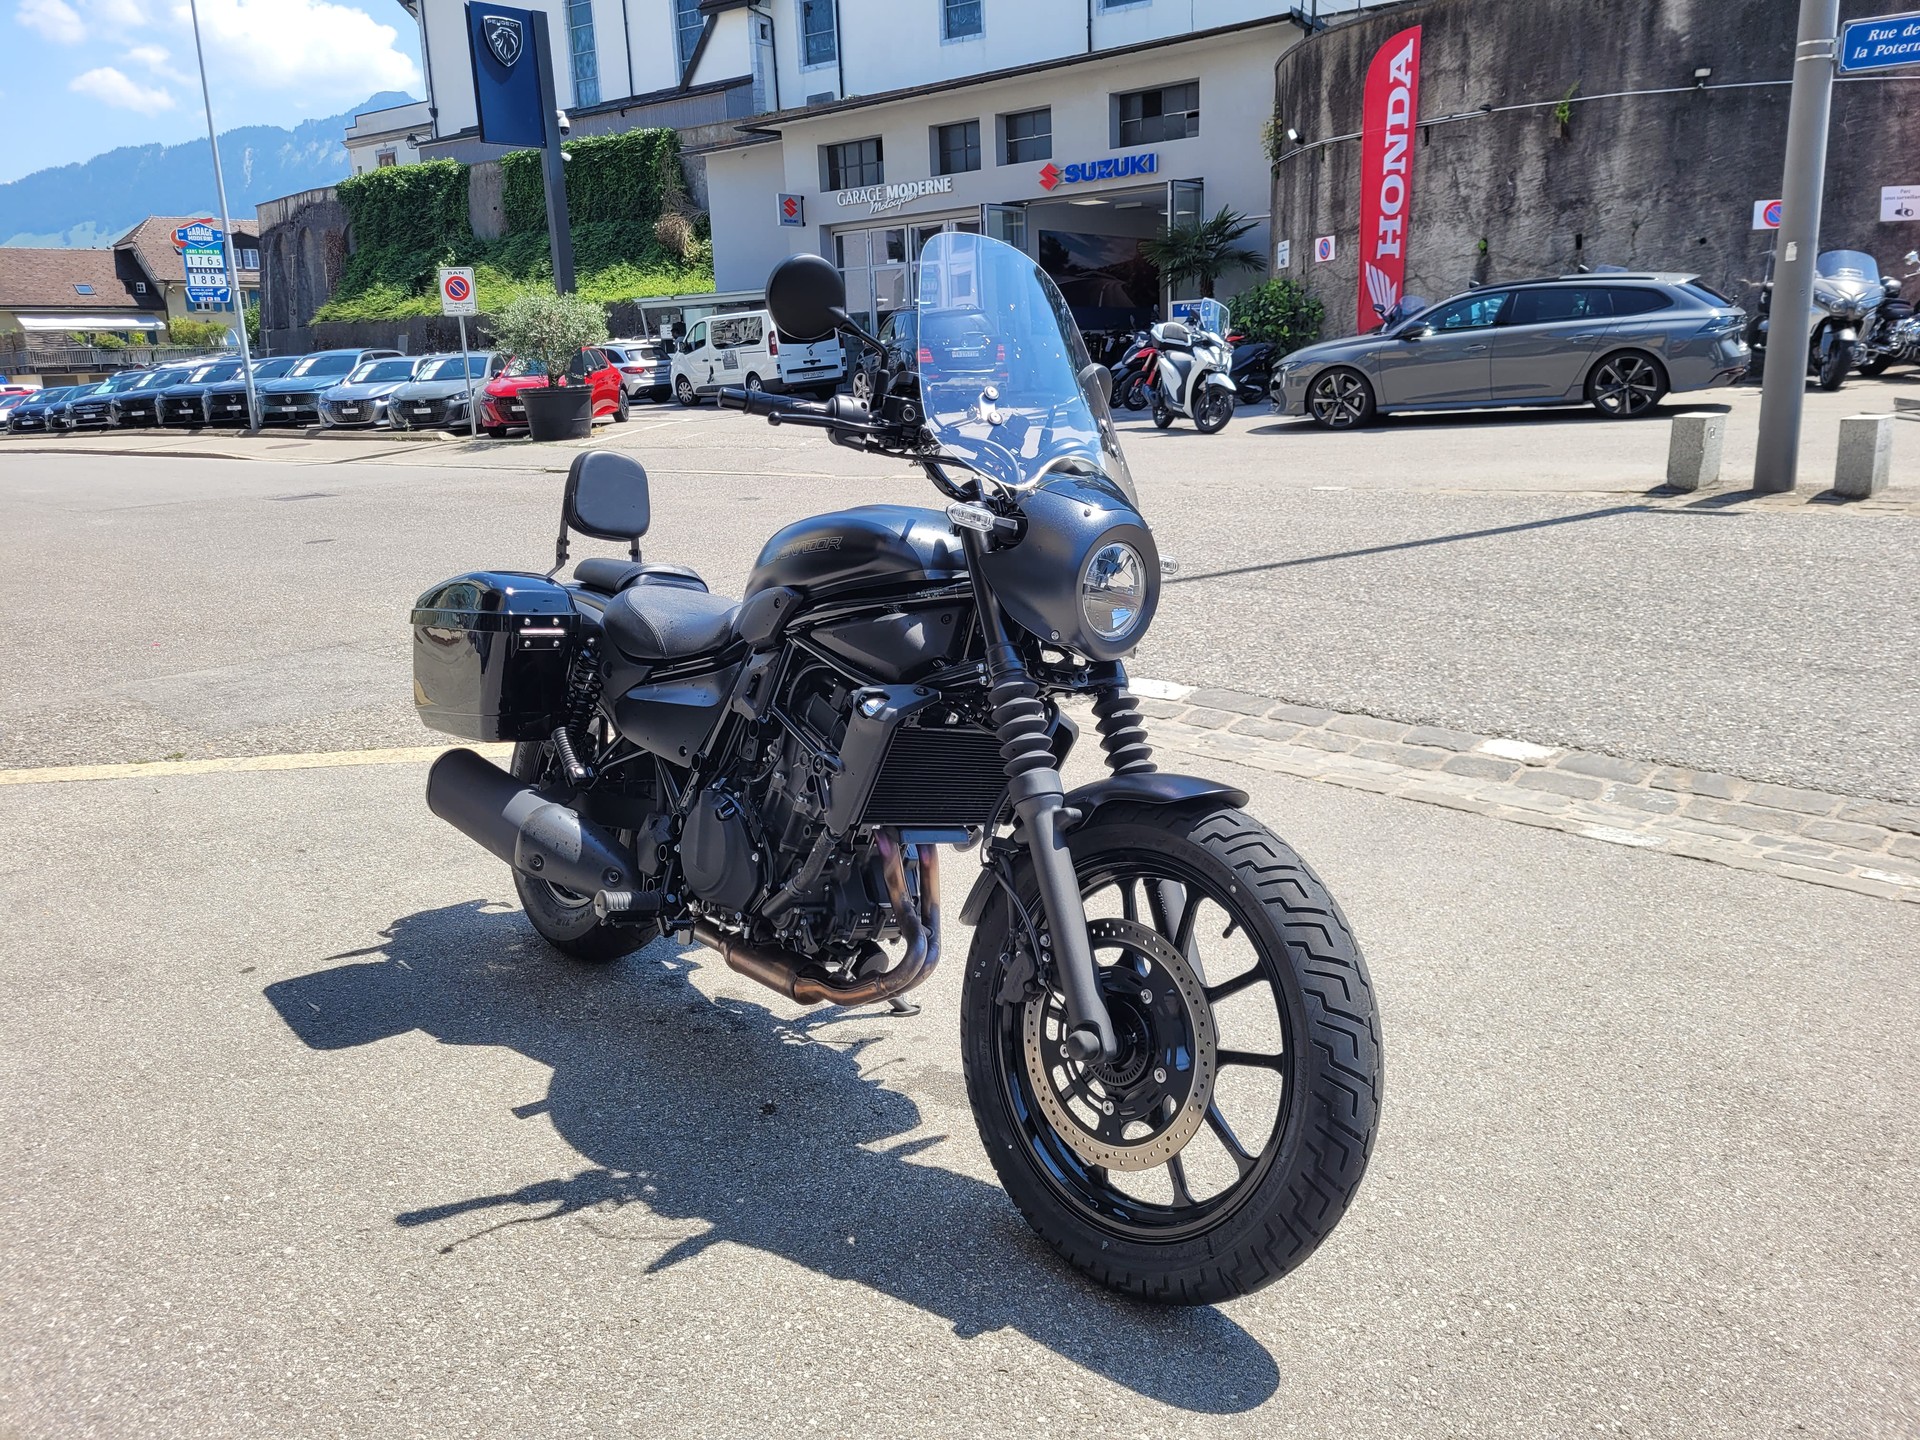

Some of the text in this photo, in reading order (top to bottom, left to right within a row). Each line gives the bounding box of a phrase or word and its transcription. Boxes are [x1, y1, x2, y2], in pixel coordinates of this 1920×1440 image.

[487, 19, 519, 28] PEUGEOT
[1867, 24, 1920, 41] Rue de
[1852, 46, 1868, 59] la
[1377, 38, 1414, 260] HONDA
[1064, 153, 1157, 183] SUZUKI
[837, 177, 952, 206] GARAGE MODERNE
[186, 227, 213, 237] GARAGE
